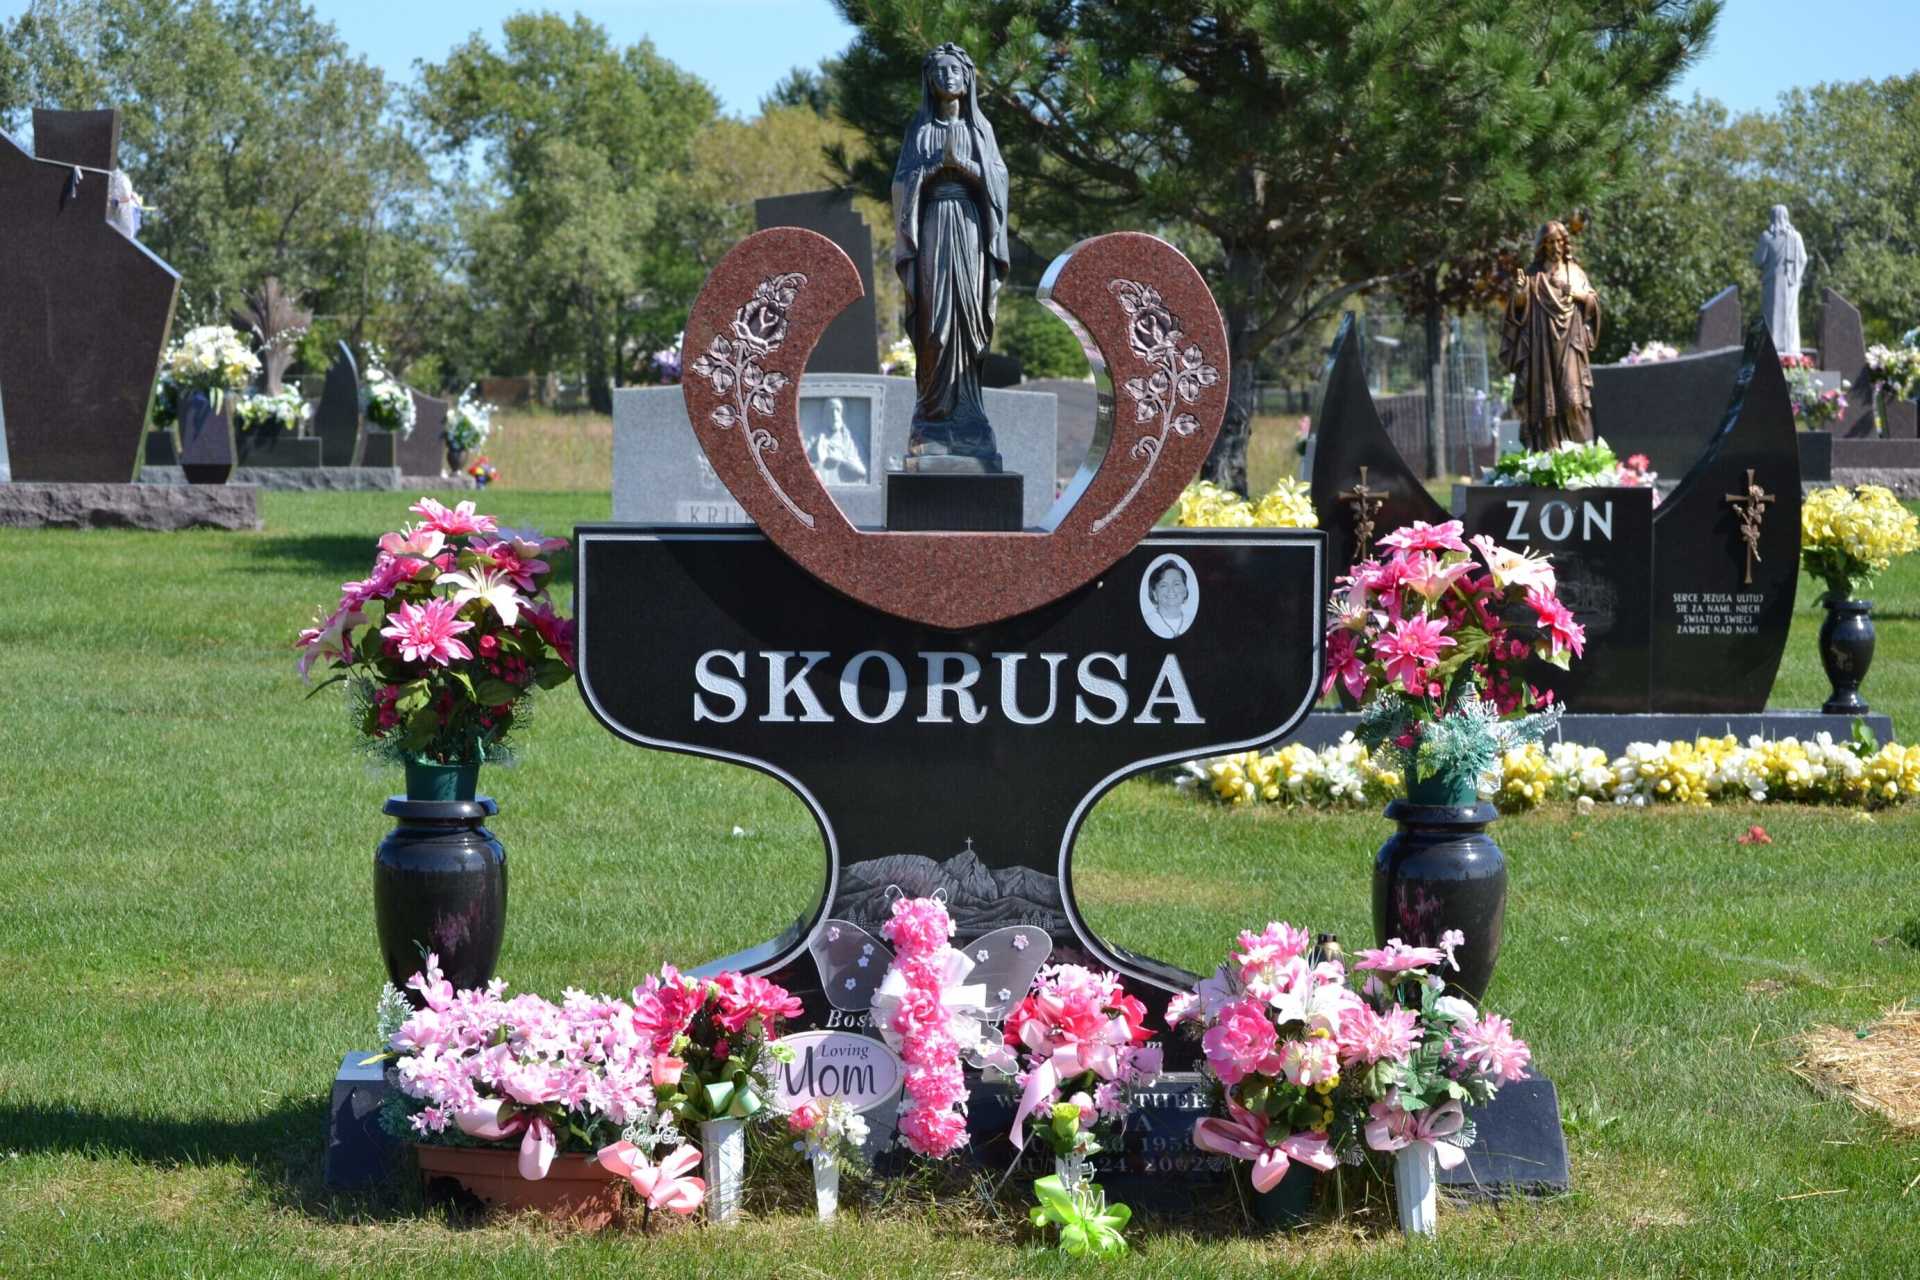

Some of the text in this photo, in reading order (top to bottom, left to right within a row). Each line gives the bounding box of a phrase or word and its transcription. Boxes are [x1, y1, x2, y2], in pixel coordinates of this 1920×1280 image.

[1506, 500, 1613, 541] ZON
[1672, 592, 1698, 602] SERCE
[1702, 592, 1733, 602] JEZUSA
[1692, 604, 1703, 613] ZA
[1736, 604, 1760, 613] NIECH
[1676, 625, 1759, 634] ZAWSZE NAD NAMI
[694, 649, 1206, 725] SKORUSA
[821, 1044, 869, 1060] Loving
[779, 1046, 877, 1097] Mom
